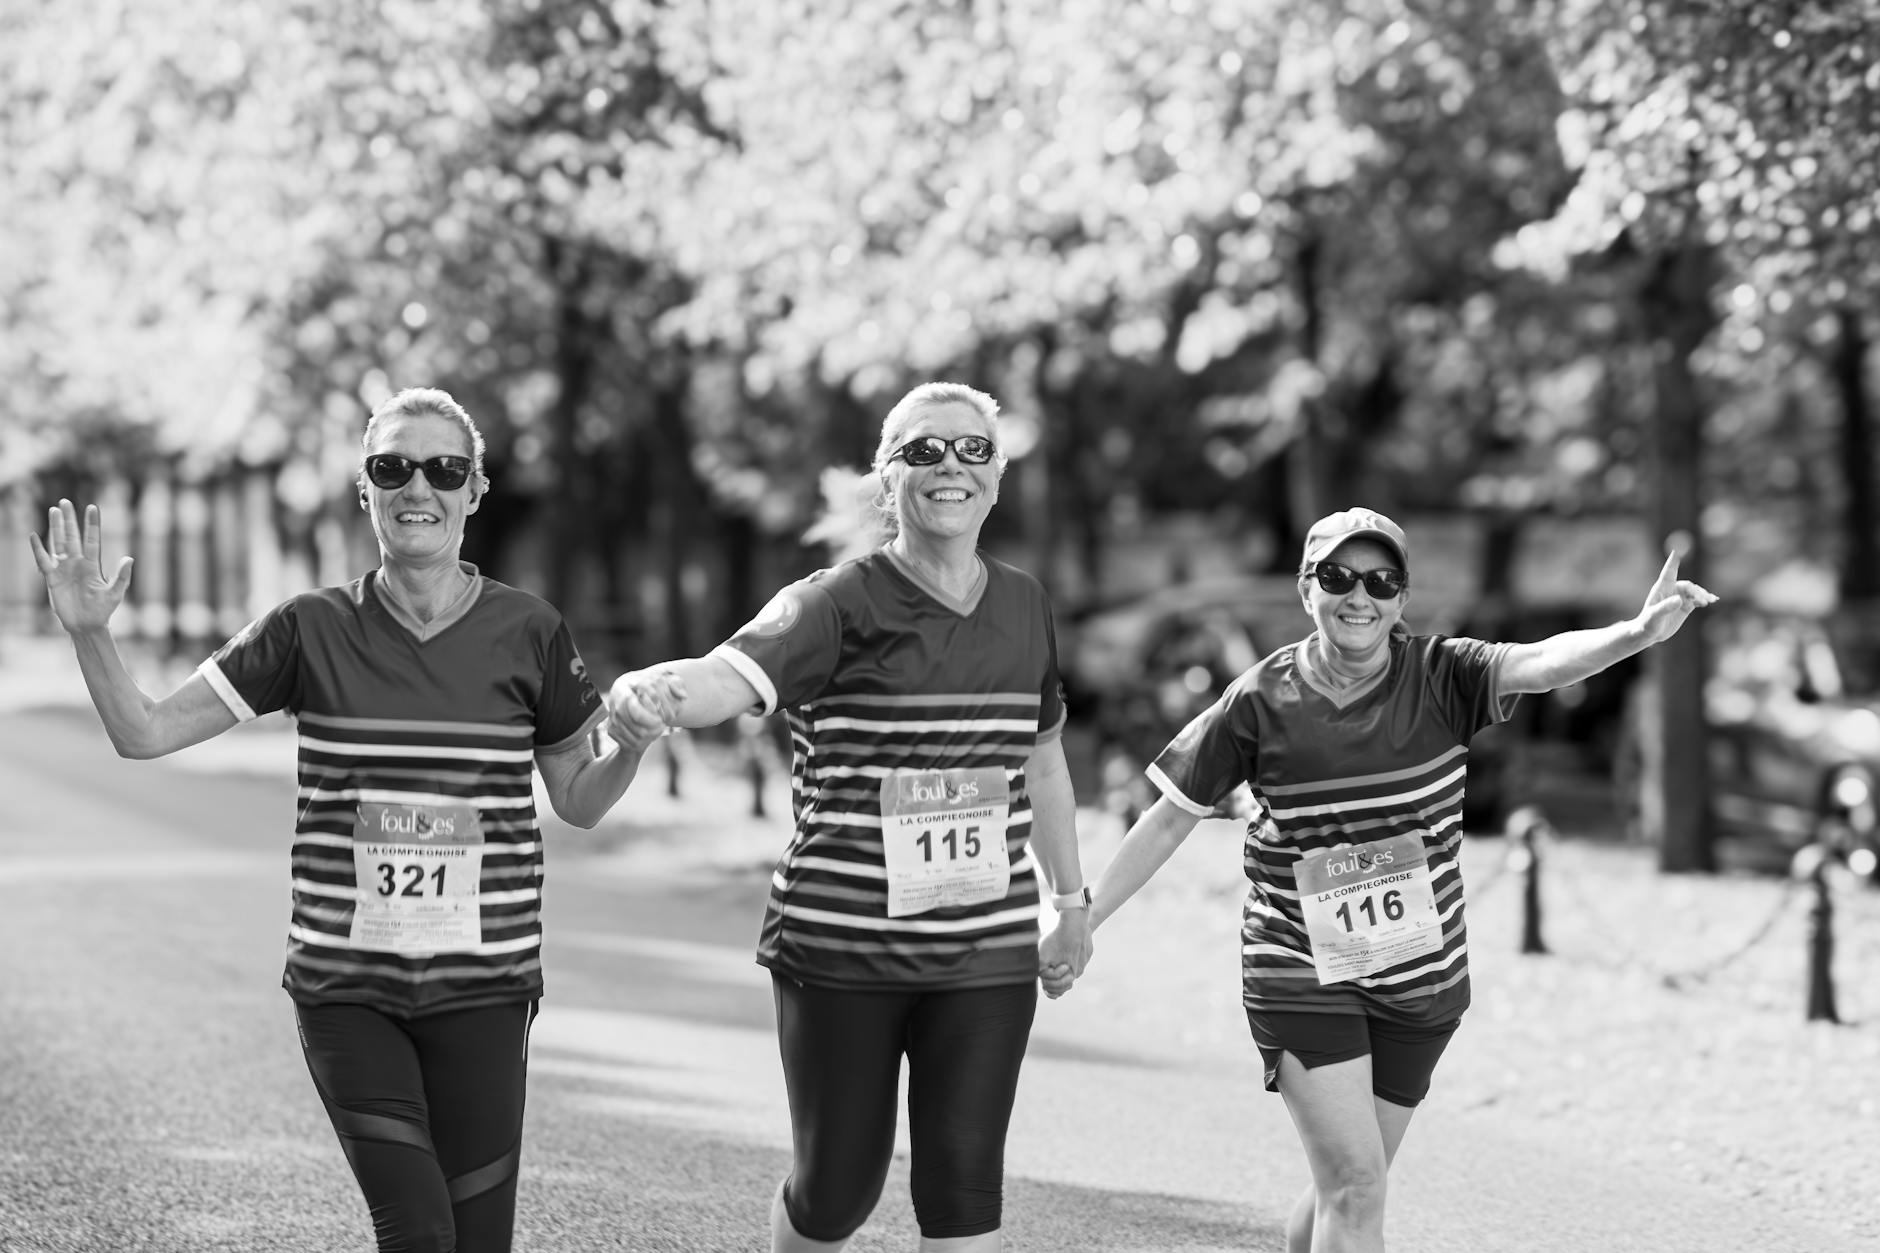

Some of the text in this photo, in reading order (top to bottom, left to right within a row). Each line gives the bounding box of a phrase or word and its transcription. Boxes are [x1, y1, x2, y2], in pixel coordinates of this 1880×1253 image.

[900, 809, 994, 826] LA COMPIEGNOISE
[367, 846, 468, 857] LA COMPIEGNOISE
[916, 826, 981, 862] 115
[377, 863, 446, 897] 321
[1318, 872, 1413, 903] LA COMPIEGNOISE
[1336, 890, 1404, 933] 116
